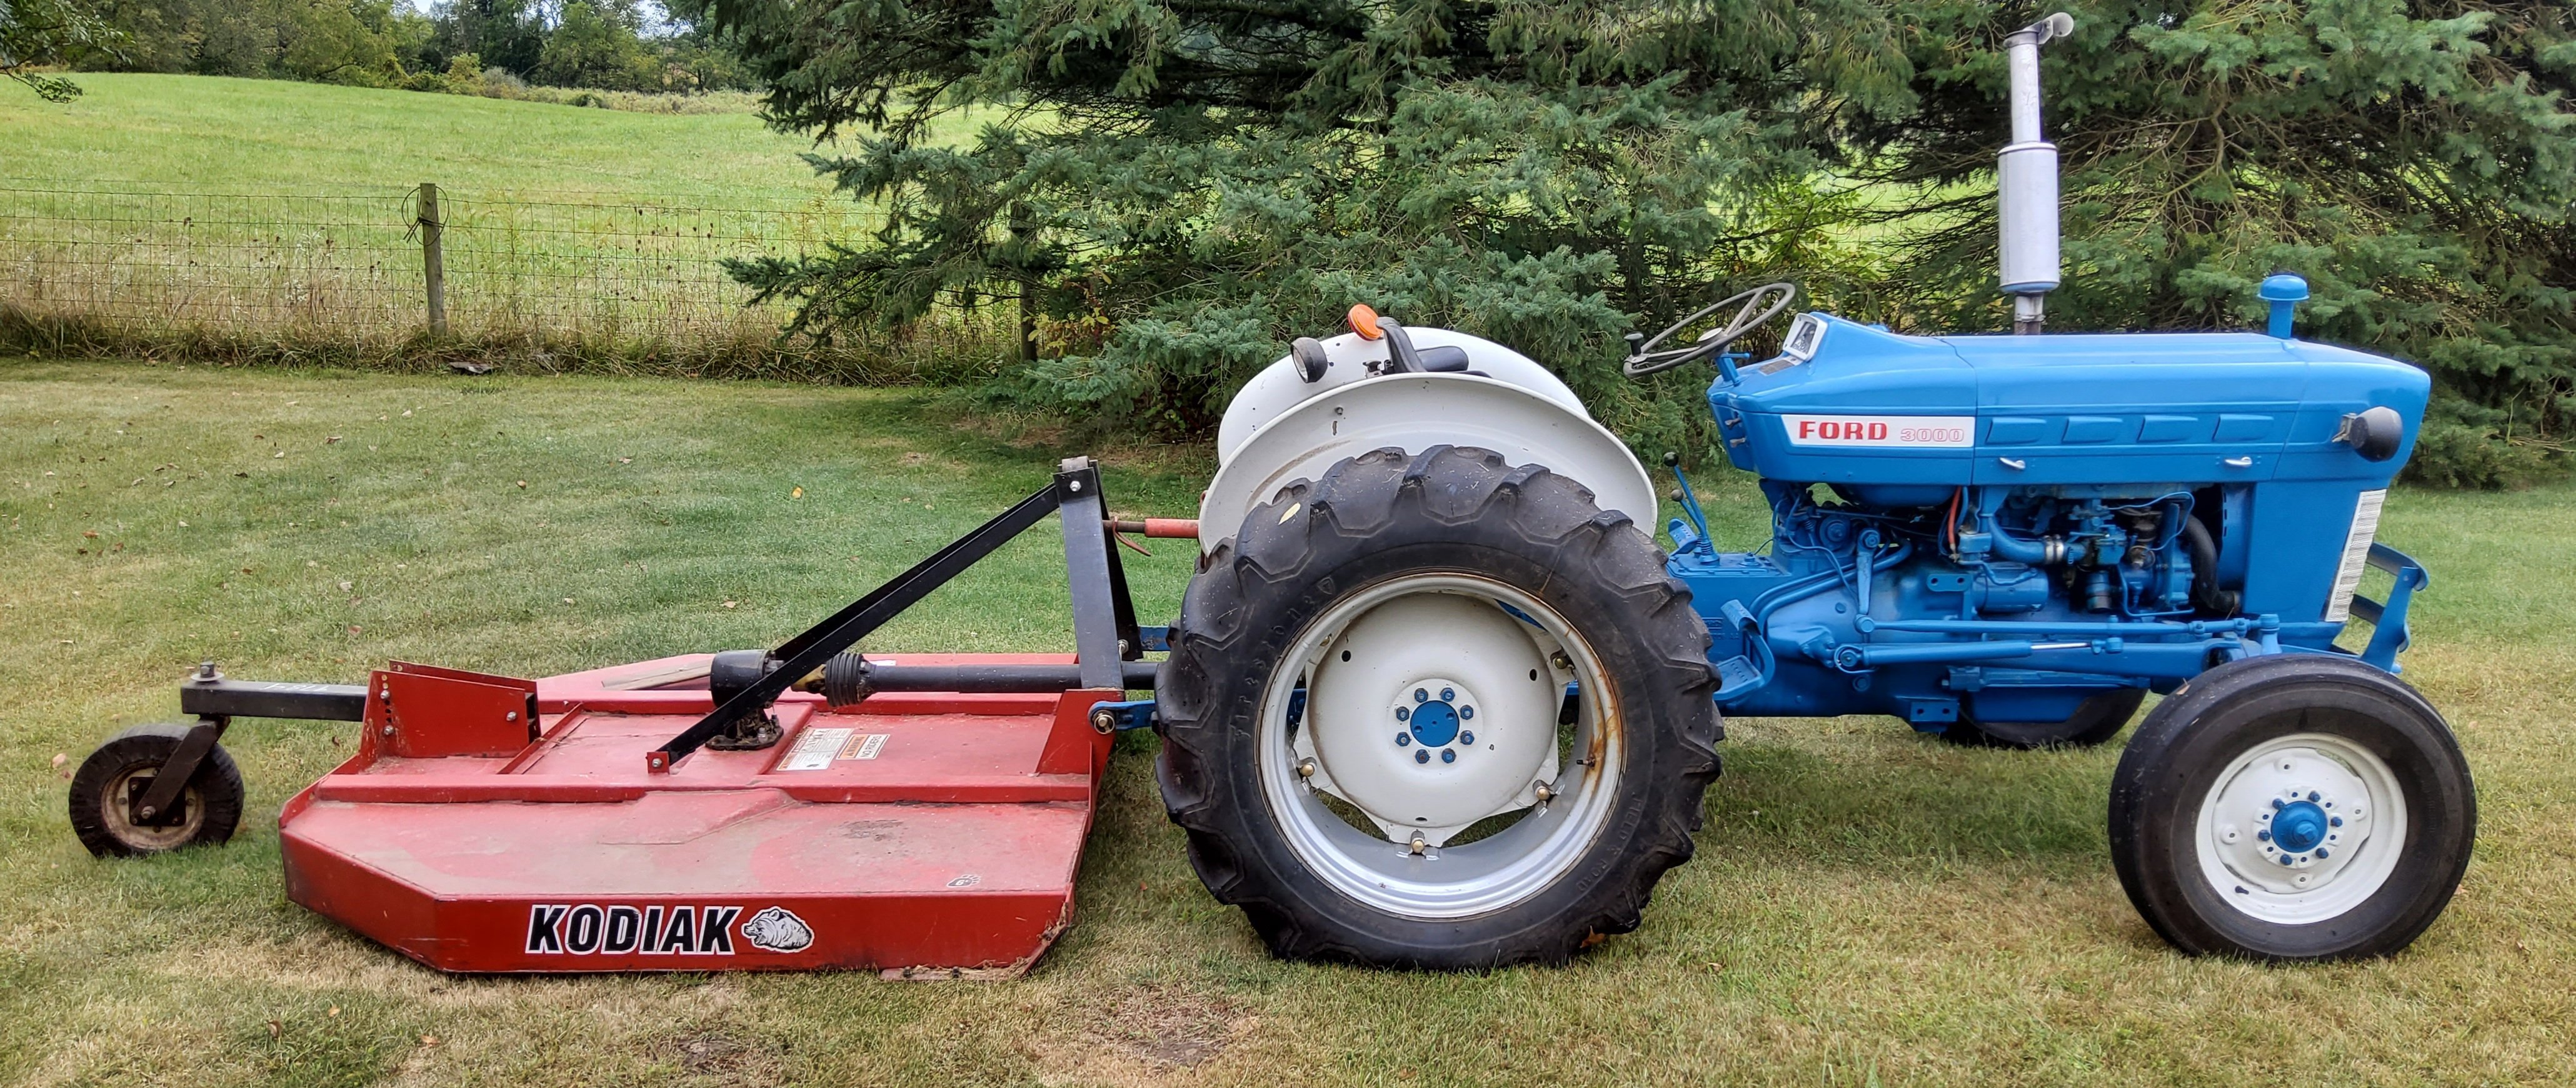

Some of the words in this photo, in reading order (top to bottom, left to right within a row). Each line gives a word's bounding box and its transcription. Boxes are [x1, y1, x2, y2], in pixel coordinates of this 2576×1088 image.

[1799, 421, 1887, 440] FORD
[1900, 429, 1964, 442] 3000
[526, 904, 743, 954] KODIAK
